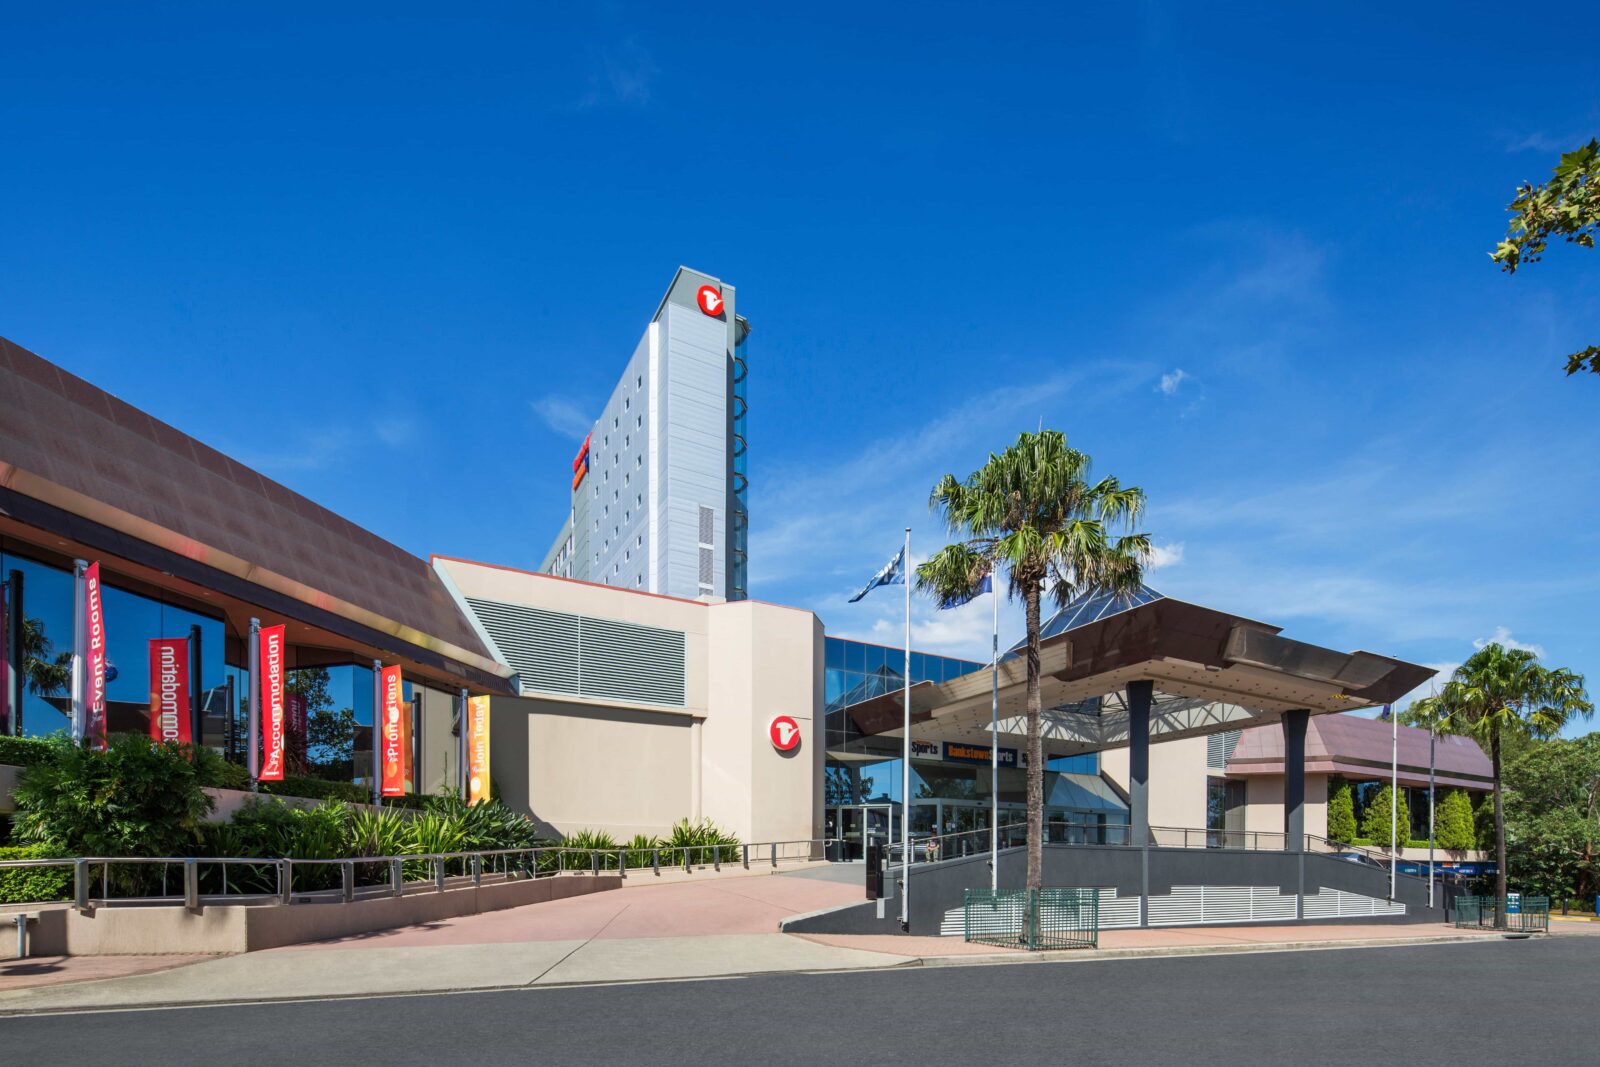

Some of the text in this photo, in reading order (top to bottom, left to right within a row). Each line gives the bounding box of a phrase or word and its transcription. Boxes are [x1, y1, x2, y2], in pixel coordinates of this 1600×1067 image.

[89, 578, 101, 650] Rooms
[92, 653, 103, 714] Event
[267, 633, 281, 760] Accommodation
[474, 702, 485, 739] Today
[474, 741, 485, 767] Join
[911, 741, 938, 757] Sports
